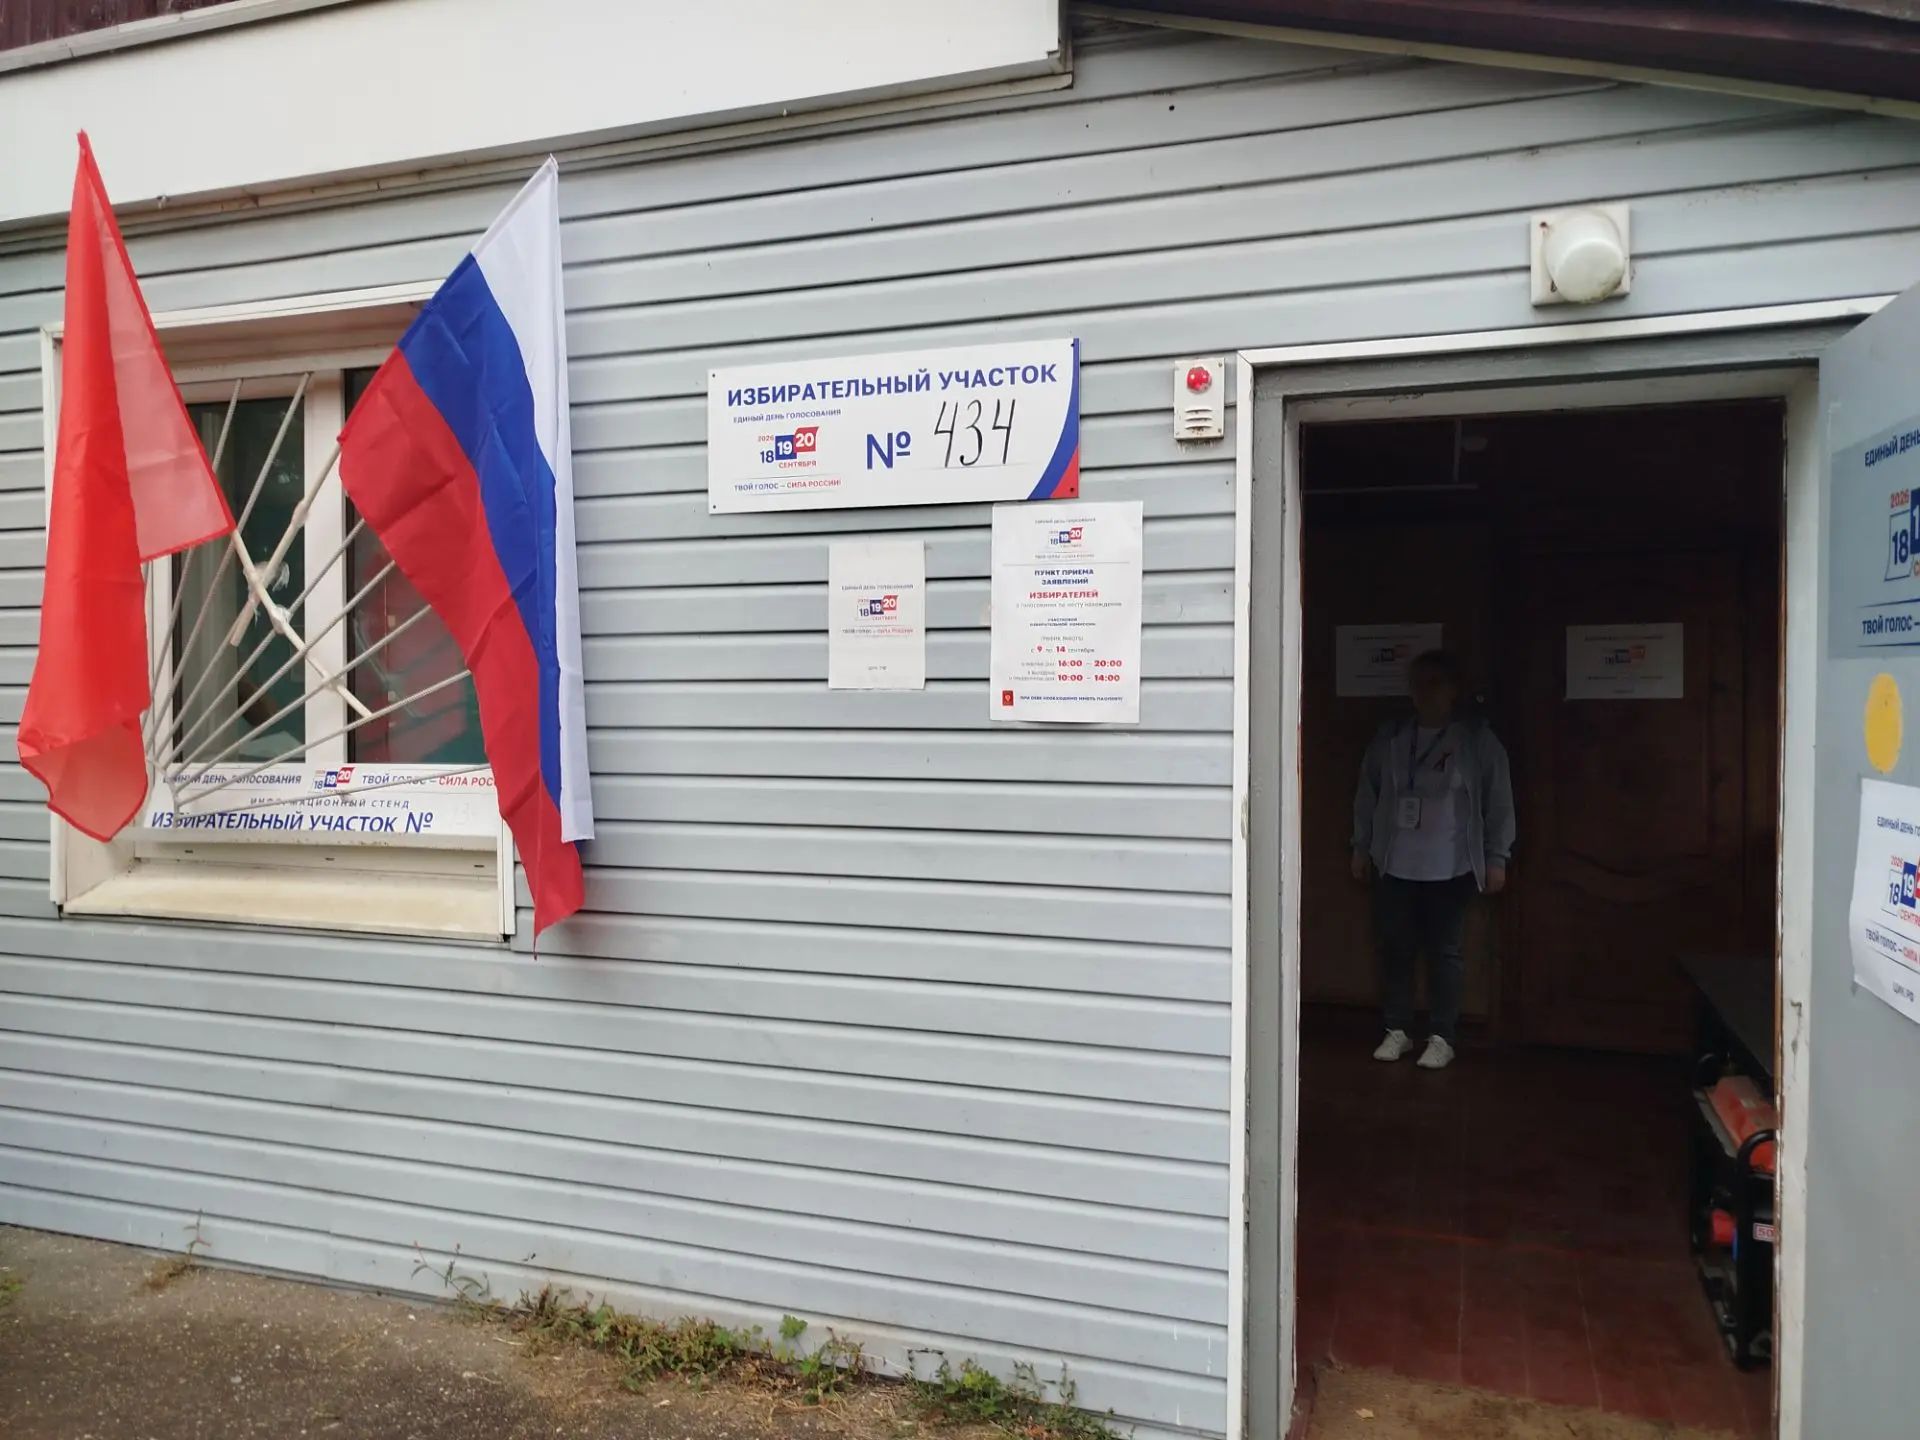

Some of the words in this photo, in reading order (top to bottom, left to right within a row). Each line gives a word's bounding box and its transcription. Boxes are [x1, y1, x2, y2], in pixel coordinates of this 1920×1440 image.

[727, 369, 931, 407] ИЗБИРАТЕЛЬНЫЙ
[940, 363, 1057, 391] УЧАСТОК
[733, 413, 764, 423] ЕДИНЫЙ
[765, 413, 784, 422] ДЕНЬ
[786, 409, 841, 419] ГОЛОСОВАНИЯ
[866, 430, 911, 470] №
[933, 398, 1017, 468] 434
[760, 450, 774, 464] 18
[777, 441, 793, 455] 19
[795, 432, 815, 447] 20
[1864, 435, 1898, 467] ЕДИНЫЙ
[778, 460, 817, 469] СЕНТЯБРЯ
[734, 482, 753, 491] ТВОЙ
[755, 482, 779, 491] ГОЛОС
[787, 480, 807, 489] СИЛА
[1070, 530, 1081, 538] 20
[1892, 529, 1908, 566] 18
[1062, 568, 1094, 576] ПРИЕМА
[1042, 577, 1089, 585] ЗАЯВЛЕНИЙ
[1029, 589, 1098, 599] ИЗБИРАТЕЛЕЙ
[859, 608, 869, 617] 18
[871, 603, 881, 612] 19
[883, 598, 896, 608] 20
[1862, 615, 1883, 635] ТВОЙ
[1885, 615, 1912, 634] ГОЛОС
[1056, 645, 1066, 653] 14
[1058, 674, 1083, 682] 10:00
[1094, 674, 1121, 682] 14:00
[326, 774, 336, 785] 19
[338, 770, 351, 781] 20
[362, 773, 390, 785] ТВОЙ
[439, 775, 468, 787] СИЛА
[371, 799, 410, 809] СТЕНД
[309, 814, 397, 833] УЧАСТОК
[405, 811, 434, 833] №
[1889, 882, 1900, 906] 18
[1903, 873, 1915, 899] 19
